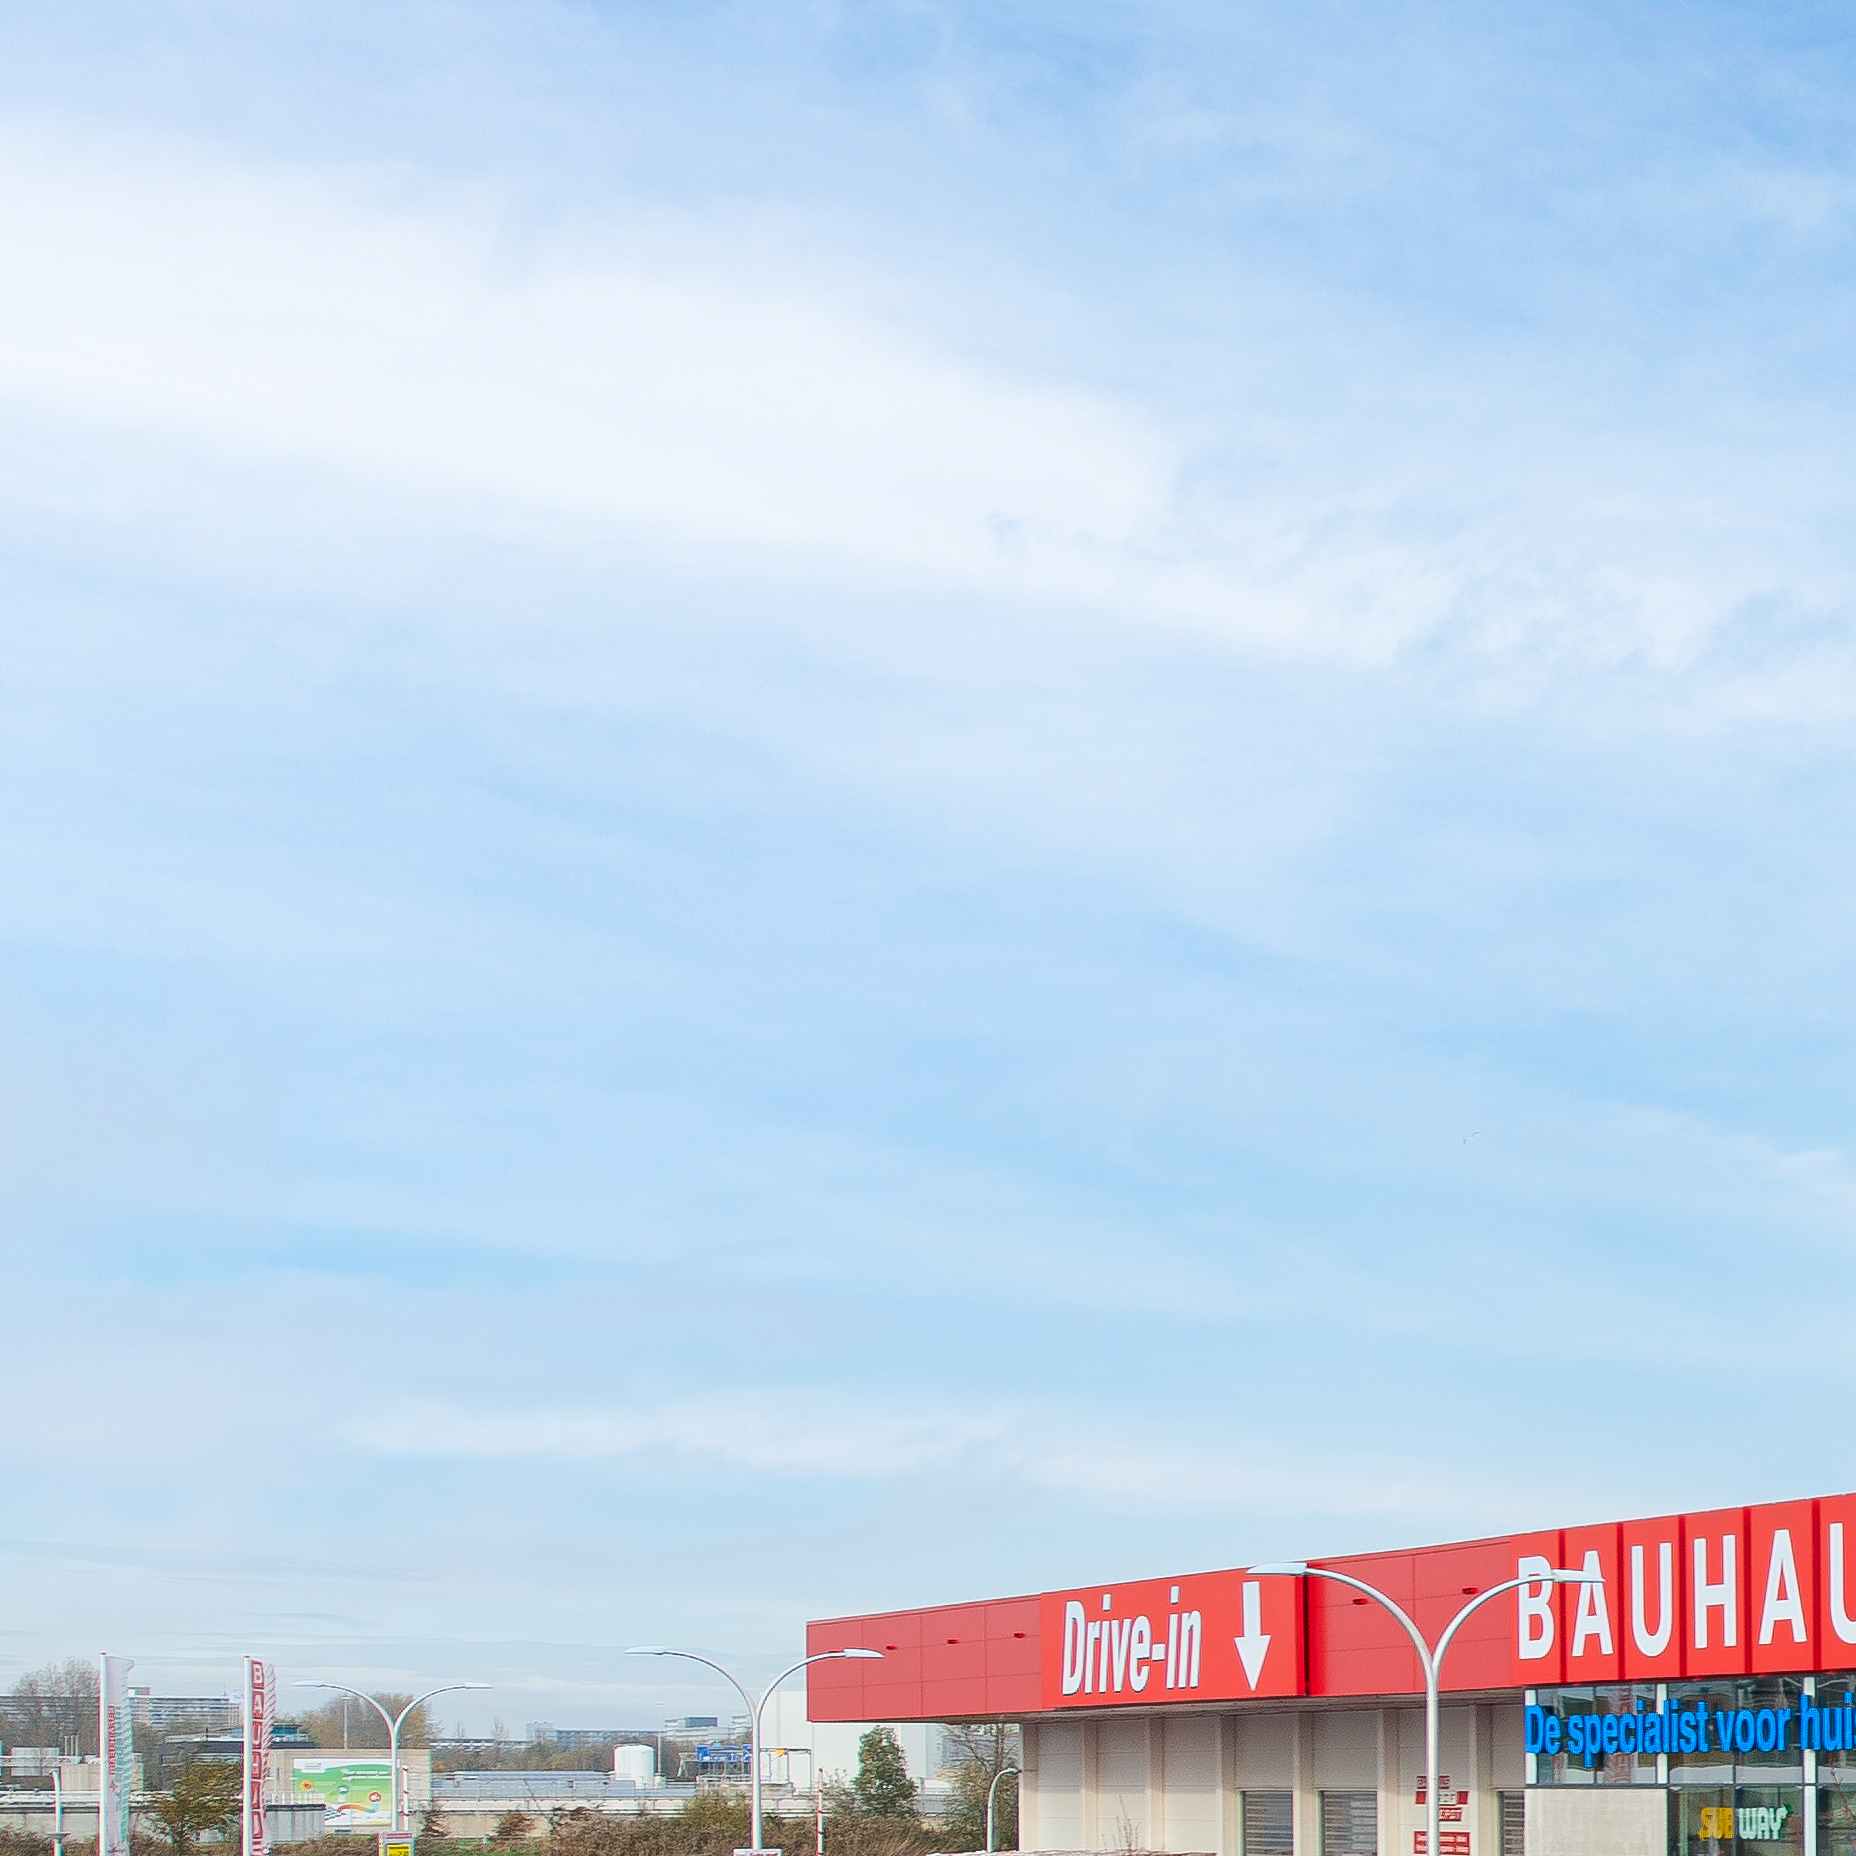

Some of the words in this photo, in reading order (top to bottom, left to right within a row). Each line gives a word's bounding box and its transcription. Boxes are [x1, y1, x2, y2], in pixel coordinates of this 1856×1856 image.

[1062, 1586, 1201, 1695] Drive-in
[1524, 1703, 1562, 1754] De
[1567, 1698, 1710, 1768] specialist
[1716, 1707, 1792, 1752] voor
